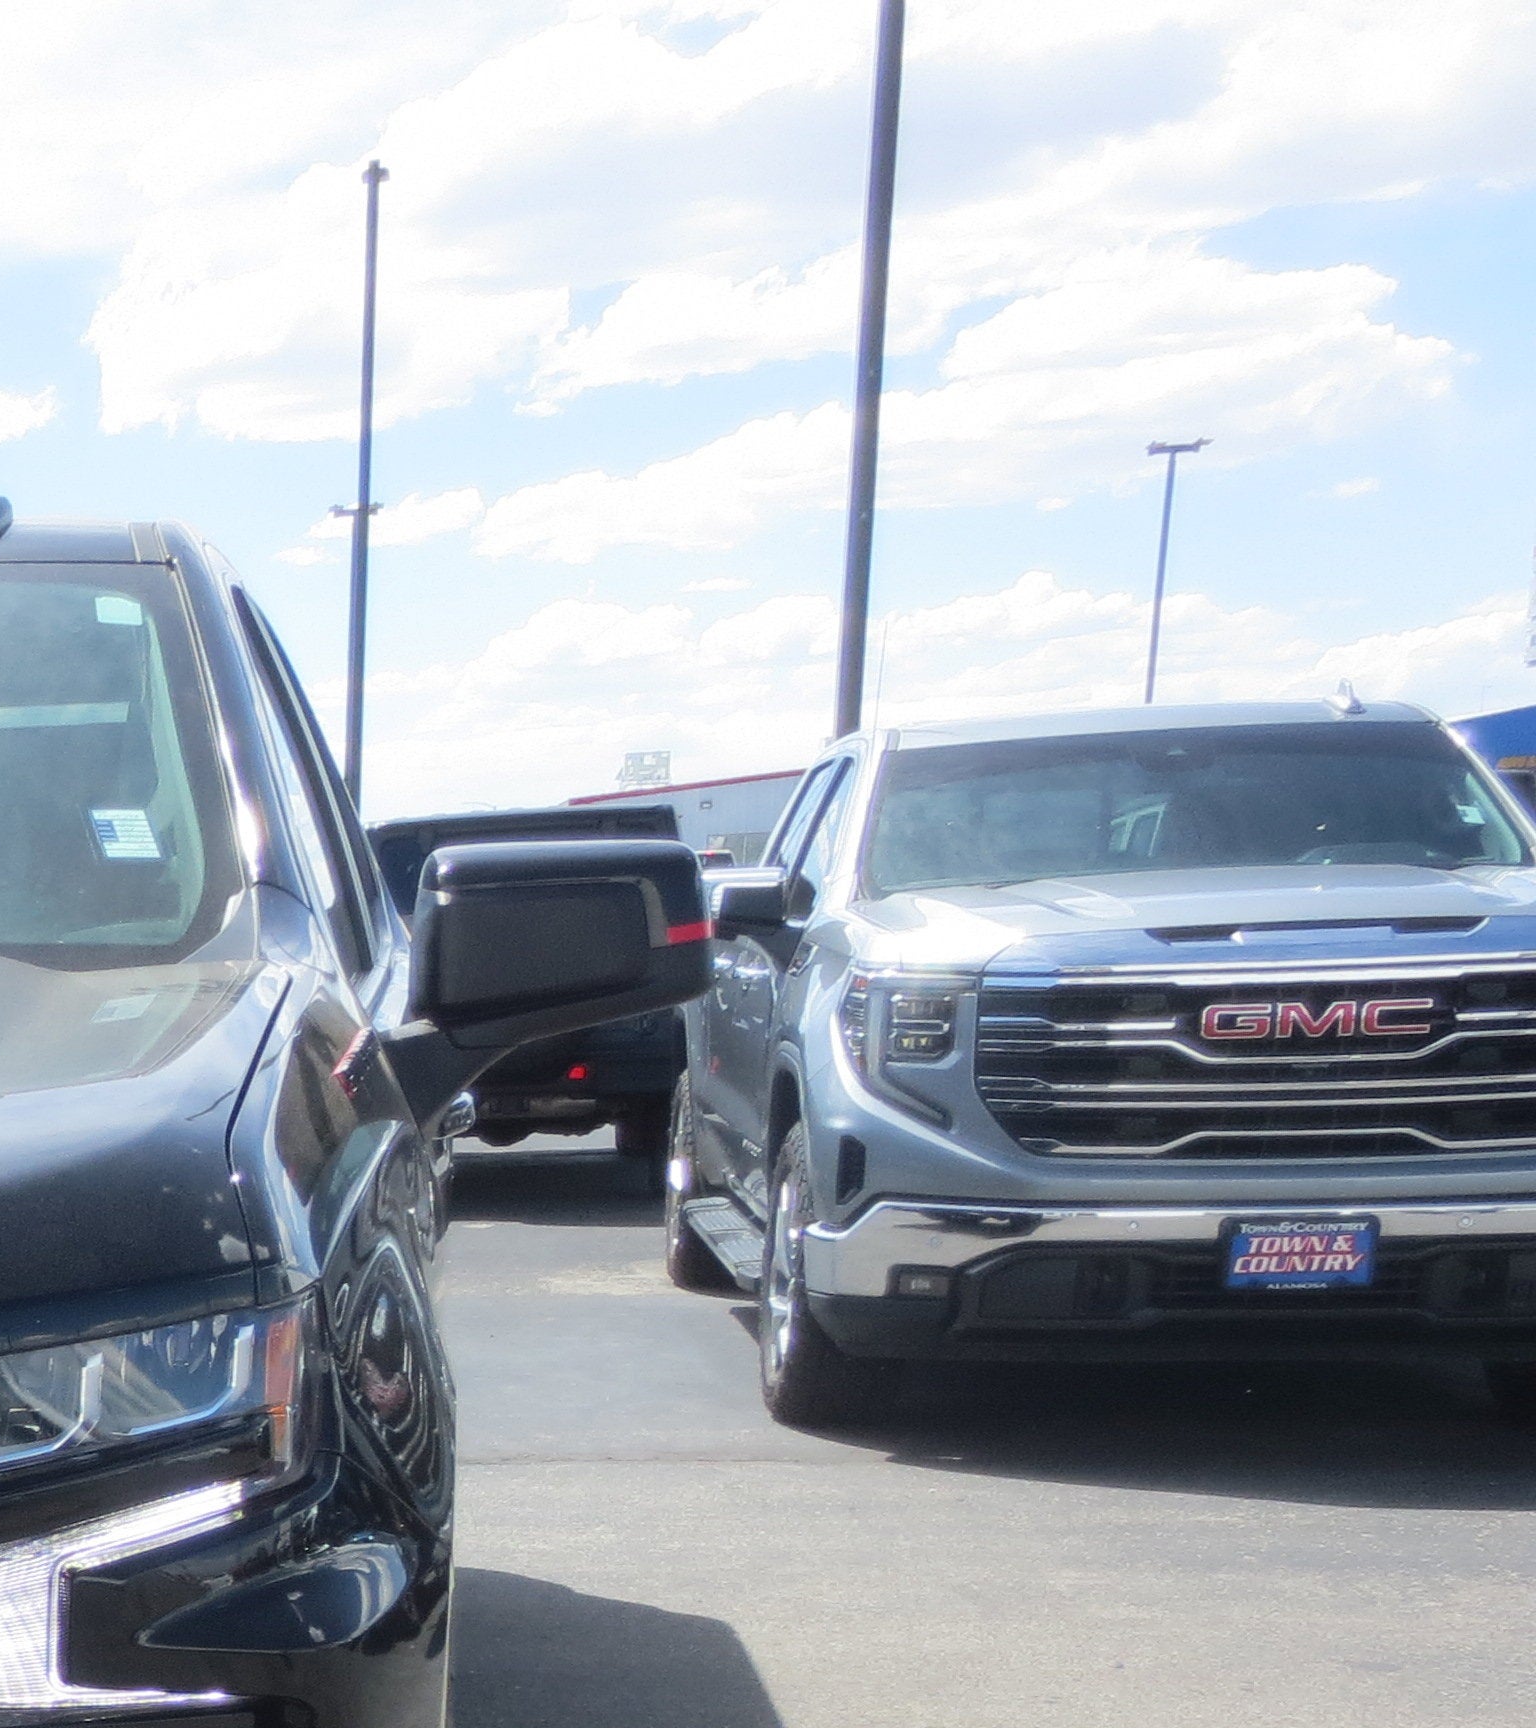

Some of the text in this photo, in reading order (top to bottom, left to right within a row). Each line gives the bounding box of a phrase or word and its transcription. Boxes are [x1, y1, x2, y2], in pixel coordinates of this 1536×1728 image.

[1201, 998, 1434, 1040] GMC
[1248, 1234, 1355, 1254] TOWN &
[1233, 1253, 1365, 1274] COUNTRY
[1265, 1282, 1328, 1290] ALAMOSA
